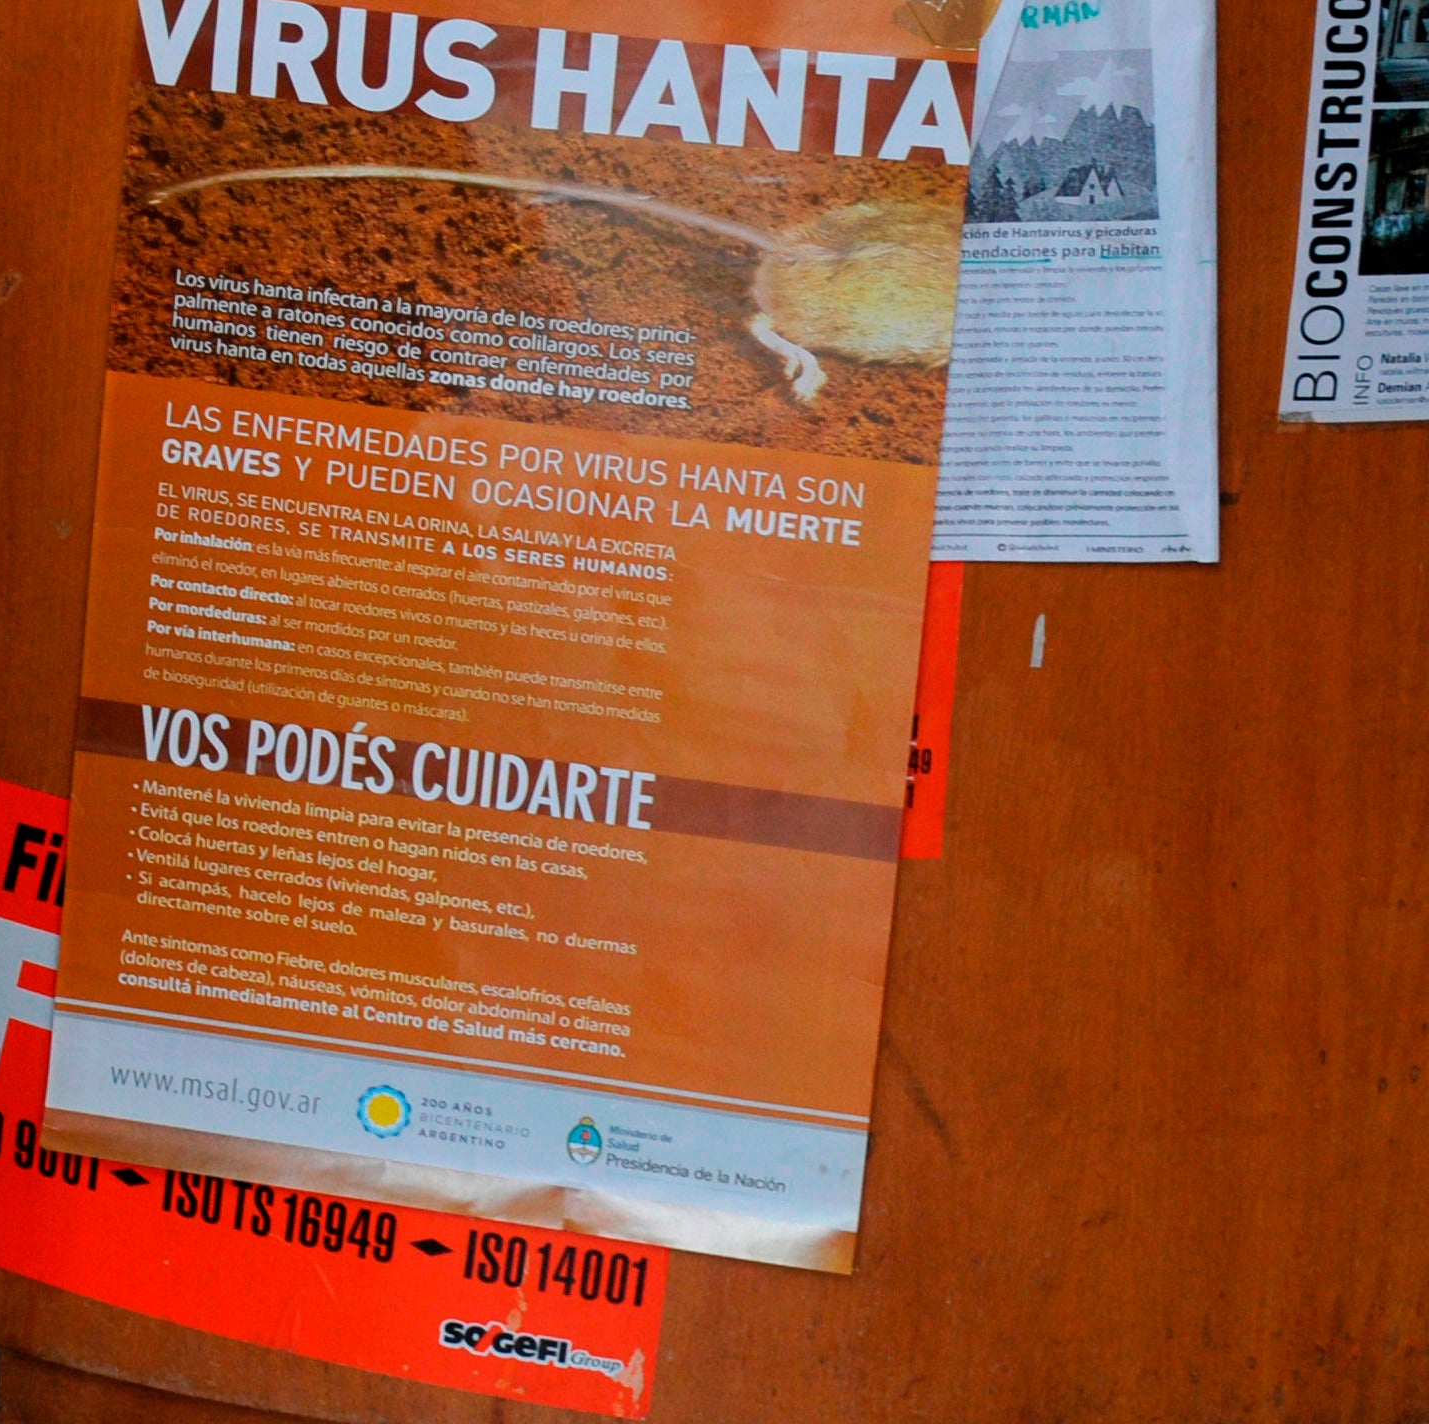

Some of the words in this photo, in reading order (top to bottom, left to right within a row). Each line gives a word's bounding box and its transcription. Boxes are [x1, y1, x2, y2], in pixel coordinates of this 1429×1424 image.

[531, 27, 975, 166] HANTA
[993, 227, 1009, 239] de
[1012, 226, 1082, 239] Hantavirus
[1085, 228, 1092, 241] y
[1095, 225, 1158, 239] picaduras
[1062, 246, 1096, 261] para
[173, 292, 258, 317] palmente
[261, 305, 272, 319] a
[277, 307, 346, 328] ratones
[350, 317, 445, 341] conocidos
[449, 329, 504, 347] como
[508, 334, 603, 359] colilargos.
[609, 335, 641, 361] Los
[646, 350, 695, 366] seres
[175, 268, 206, 288] Los
[208, 274, 250, 294] virus
[253, 278, 304, 301] hanta
[307, 286, 379, 311] infectan
[381, 299, 393, 313] a
[396, 296, 412, 315] la
[415, 303, 488, 324] mayoría
[491, 308, 516, 327] de
[519, 310, 545, 330] los
[548, 317, 635, 341] roedores;
[637, 325, 697, 344] princi-
[170, 334, 213, 354] virus
[216, 338, 267, 361] hanta
[270, 350, 294, 365] en
[297, 351, 347, 372] todas
[350, 360, 426, 382] aquellas
[428, 357, 487, 389] zonas
[489, 373, 555, 396] donde
[558, 380, 595, 404] hay
[598, 377, 692, 409] roedores.
[1352, 354, 1374, 406] INFO
[1380, 351, 1422, 367] Natalia
[1378, 381, 1422, 395] Demian
[165, 400, 222, 433] LAS
[232, 409, 488, 467] ENFERMEDADES
[499, 443, 564, 475] POR
[574, 451, 668, 487] VIRUS
[679, 462, 786, 500] HANTA
[796, 475, 865, 509] SON
[161, 438, 281, 478] GRAVES
[294, 455, 313, 482] Y
[326, 459, 455, 501] PUEDEN
[471, 478, 655, 523] OCASIONAR
[671, 500, 710, 530] LA
[725, 506, 863, 547] MUERTE
[142, 704, 230, 772] VOS
[245, 719, 396, 795] PODÉS
[412, 741, 657, 831] CUIDARTE
[110, 1064, 322, 1117] www.msal.gov.ar
[421, 1095, 447, 1112] 200
[451, 1098, 495, 1118] AÑOS
[417, 1128, 506, 1152] ARGENTINO
[419, 1112, 531, 1139] BICENTENARIO
[606, 1136, 640, 1153] Salud
[608, 1123, 659, 1144] Ministerio
[660, 1131, 673, 1144] de
[605, 1151, 690, 1180] Presidencia
[692, 1163, 711, 1181] de
[715, 1166, 728, 1184] la
[732, 1167, 787, 1194] Nación
[162, 1168, 222, 1226] ISO
[229, 1177, 274, 1238] TS
[284, 1192, 398, 1264] 16949
[462, 1227, 526, 1289] ISO
[537, 1242, 647, 1307] 14001
[569, 1346, 622, 1376] Group
